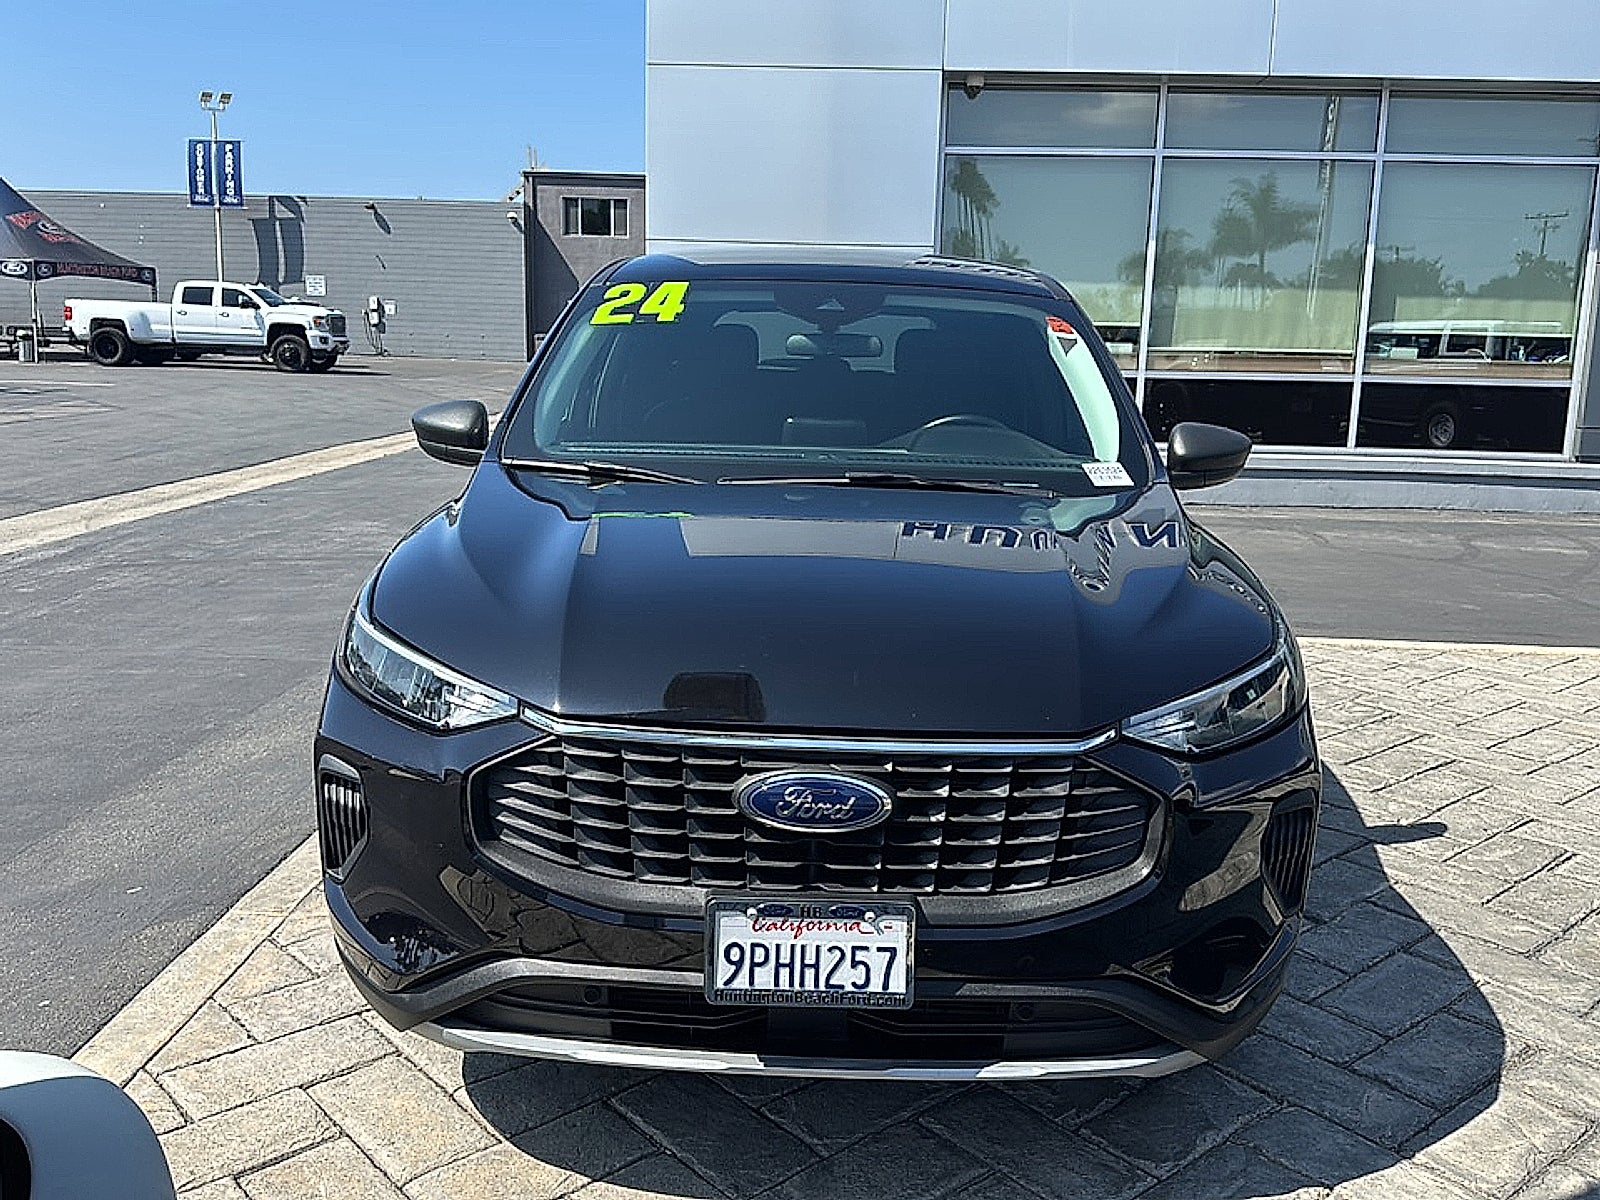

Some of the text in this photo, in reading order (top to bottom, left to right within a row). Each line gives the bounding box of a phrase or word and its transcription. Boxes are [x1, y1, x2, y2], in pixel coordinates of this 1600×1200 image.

[590, 281, 690, 325] 24
[775, 786, 857, 820] Ford
[752, 917, 875, 940] California
[723, 941, 898, 991] 9PHH257
